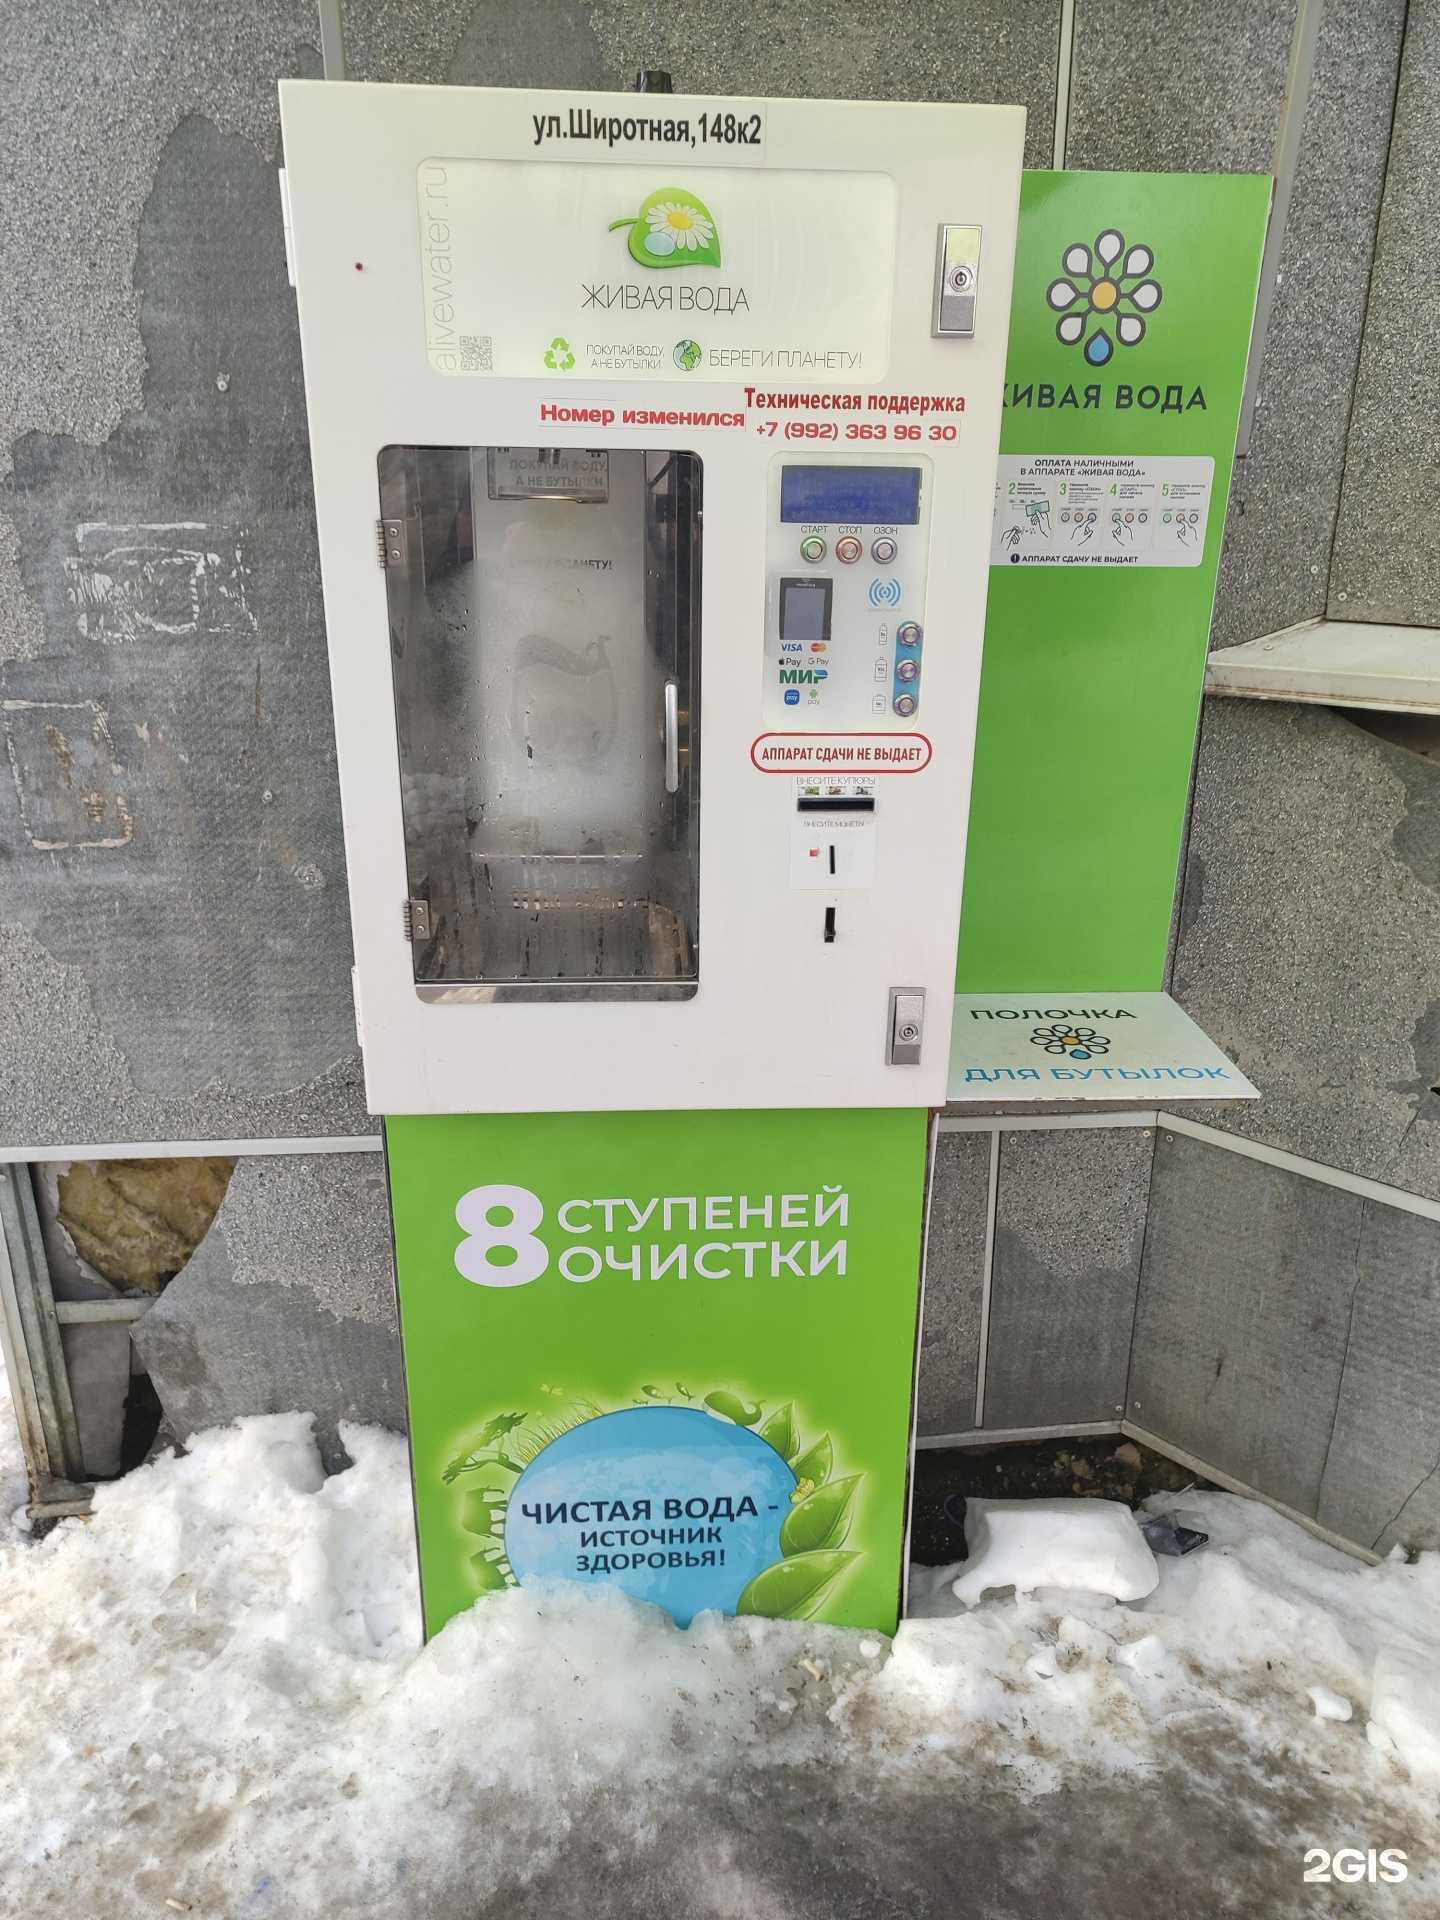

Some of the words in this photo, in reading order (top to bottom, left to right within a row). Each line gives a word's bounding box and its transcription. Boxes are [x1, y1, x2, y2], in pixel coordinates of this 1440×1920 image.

[532, 108, 762, 148] ул.Широтная,148к2
[424, 166, 457, 371] alivewater.ru
[581, 283, 673, 310] ЖИВАЯ
[679, 286, 750, 316] ВОДА
[586, 343, 635, 356] ПОКУПАЙ
[591, 358, 599, 369] А
[600, 358, 613, 369] НЕ
[709, 349, 773, 367] БЕРЕГИ
[777, 350, 862, 369] ПЛАНЕТУ!
[744, 387, 862, 411] Техническая
[867, 393, 966, 416] поддержка
[1115, 384, 1208, 414] ВОДА
[540, 404, 615, 425] Номер
[622, 408, 745, 427] изменился
[756, 421, 778, 437] +7
[784, 421, 839, 441] (992)
[845, 423, 887, 440] 363
[893, 424, 922, 440] 96
[928, 425, 957, 441] 30
[1034, 459, 1072, 467] ОПЛАТА
[1073, 459, 1134, 468] НАЛИЧНЫМИ
[1020, 468, 1027, 476] В
[1029, 468, 1075, 476] АППАРАТЕ
[1008, 482, 1016, 496] 2
[1059, 483, 1067, 496] 3
[1110, 483, 1118, 496] 4
[1161, 484, 1170, 497] 5
[800, 525, 828, 534] СТАРТ
[838, 526, 862, 534] СТОП
[874, 527, 898, 535] ОЗОН
[1022, 555, 1060, 563] АППАРАТ
[1062, 555, 1089, 564] СДАЧУ
[1104, 556, 1138, 564] ВЫДАЕТ
[781, 643, 803, 652] VISA
[786, 657, 801, 667] Pay
[816, 657, 829, 666] Pay
[779, 669, 829, 684] МИР
[762, 747, 813, 761] АППАРАТ
[816, 747, 854, 763] СДАЧИ
[857, 747, 871, 760] НЕ
[874, 748, 922, 762] ВЫДАЕТ
[796, 776, 837, 785] ВНЕСИТЕ
[970, 1008, 1137, 1020] ПОЛОЧКА
[965, 1067, 1041, 1082] ДЛЯ
[1050, 1067, 1233, 1080] БУТЫЛОК
[557, 1184, 850, 1234] СТУПЕНЕЙ
[454, 1184, 550, 1288] 8
[558, 1239, 848, 1284] ОЧИСТКИ
[521, 1499, 651, 1525] ЧИСТАЯ
[663, 1496, 759, 1523] ВОДА
[580, 1526, 723, 1548] ИСТОЧНИК
[576, 1549, 726, 1575] ЗДОРОВЬЯ!
